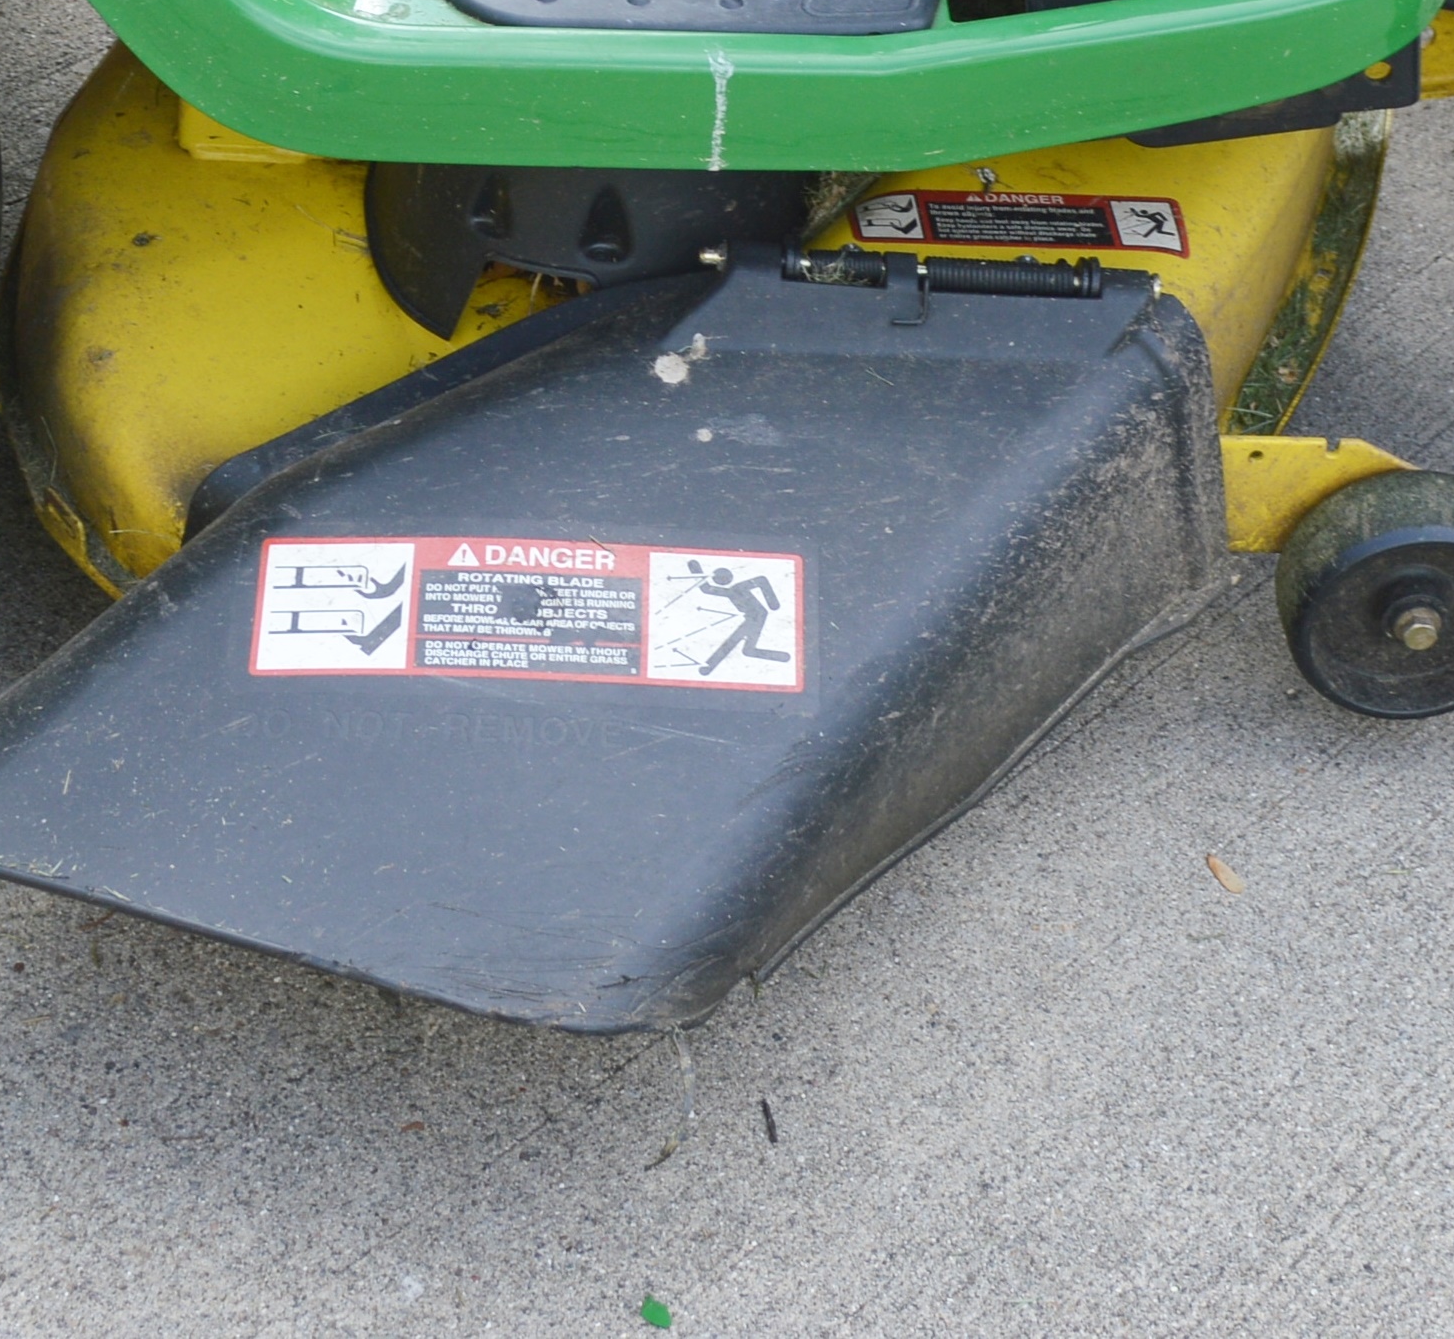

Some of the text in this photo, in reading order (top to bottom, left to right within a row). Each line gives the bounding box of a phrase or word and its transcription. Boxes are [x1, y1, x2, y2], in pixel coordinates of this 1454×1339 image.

[984, 193, 1065, 205] DANGER
[484, 544, 616, 571] DANGER
[457, 572, 605, 589] ROTATING BLADE
[425, 583, 443, 592] DO
[444, 583, 467, 592] NOT
[469, 584, 491, 593] PUT
[580, 589, 618, 599] UNDER
[619, 591, 636, 600] OR
[425, 592, 451, 601] INTO
[453, 593, 495, 602] MOWER
[573, 598, 586, 607] IS
[587, 599, 636, 610] RUNNING
[450, 603, 498, 614] THRO
[422, 623, 451, 632] THAT
[452, 624, 476, 633] MAY
[477, 625, 493, 634] BE
[423, 614, 464, 623] BEFORE
[574, 620, 589, 629] OF
[425, 640, 443, 649] DO
[445, 641, 470, 650] NOT
[471, 641, 528, 652] OPERATE
[528, 644, 573, 655] MOWER
[424, 656, 529, 668] CATCHER IN PLACE
[425, 648, 628, 666] DISCHARGE CHUTE OR ENTIRE GRASS
[324, 709, 415, 742] NOT
[440, 711, 625, 750] REMOVE
